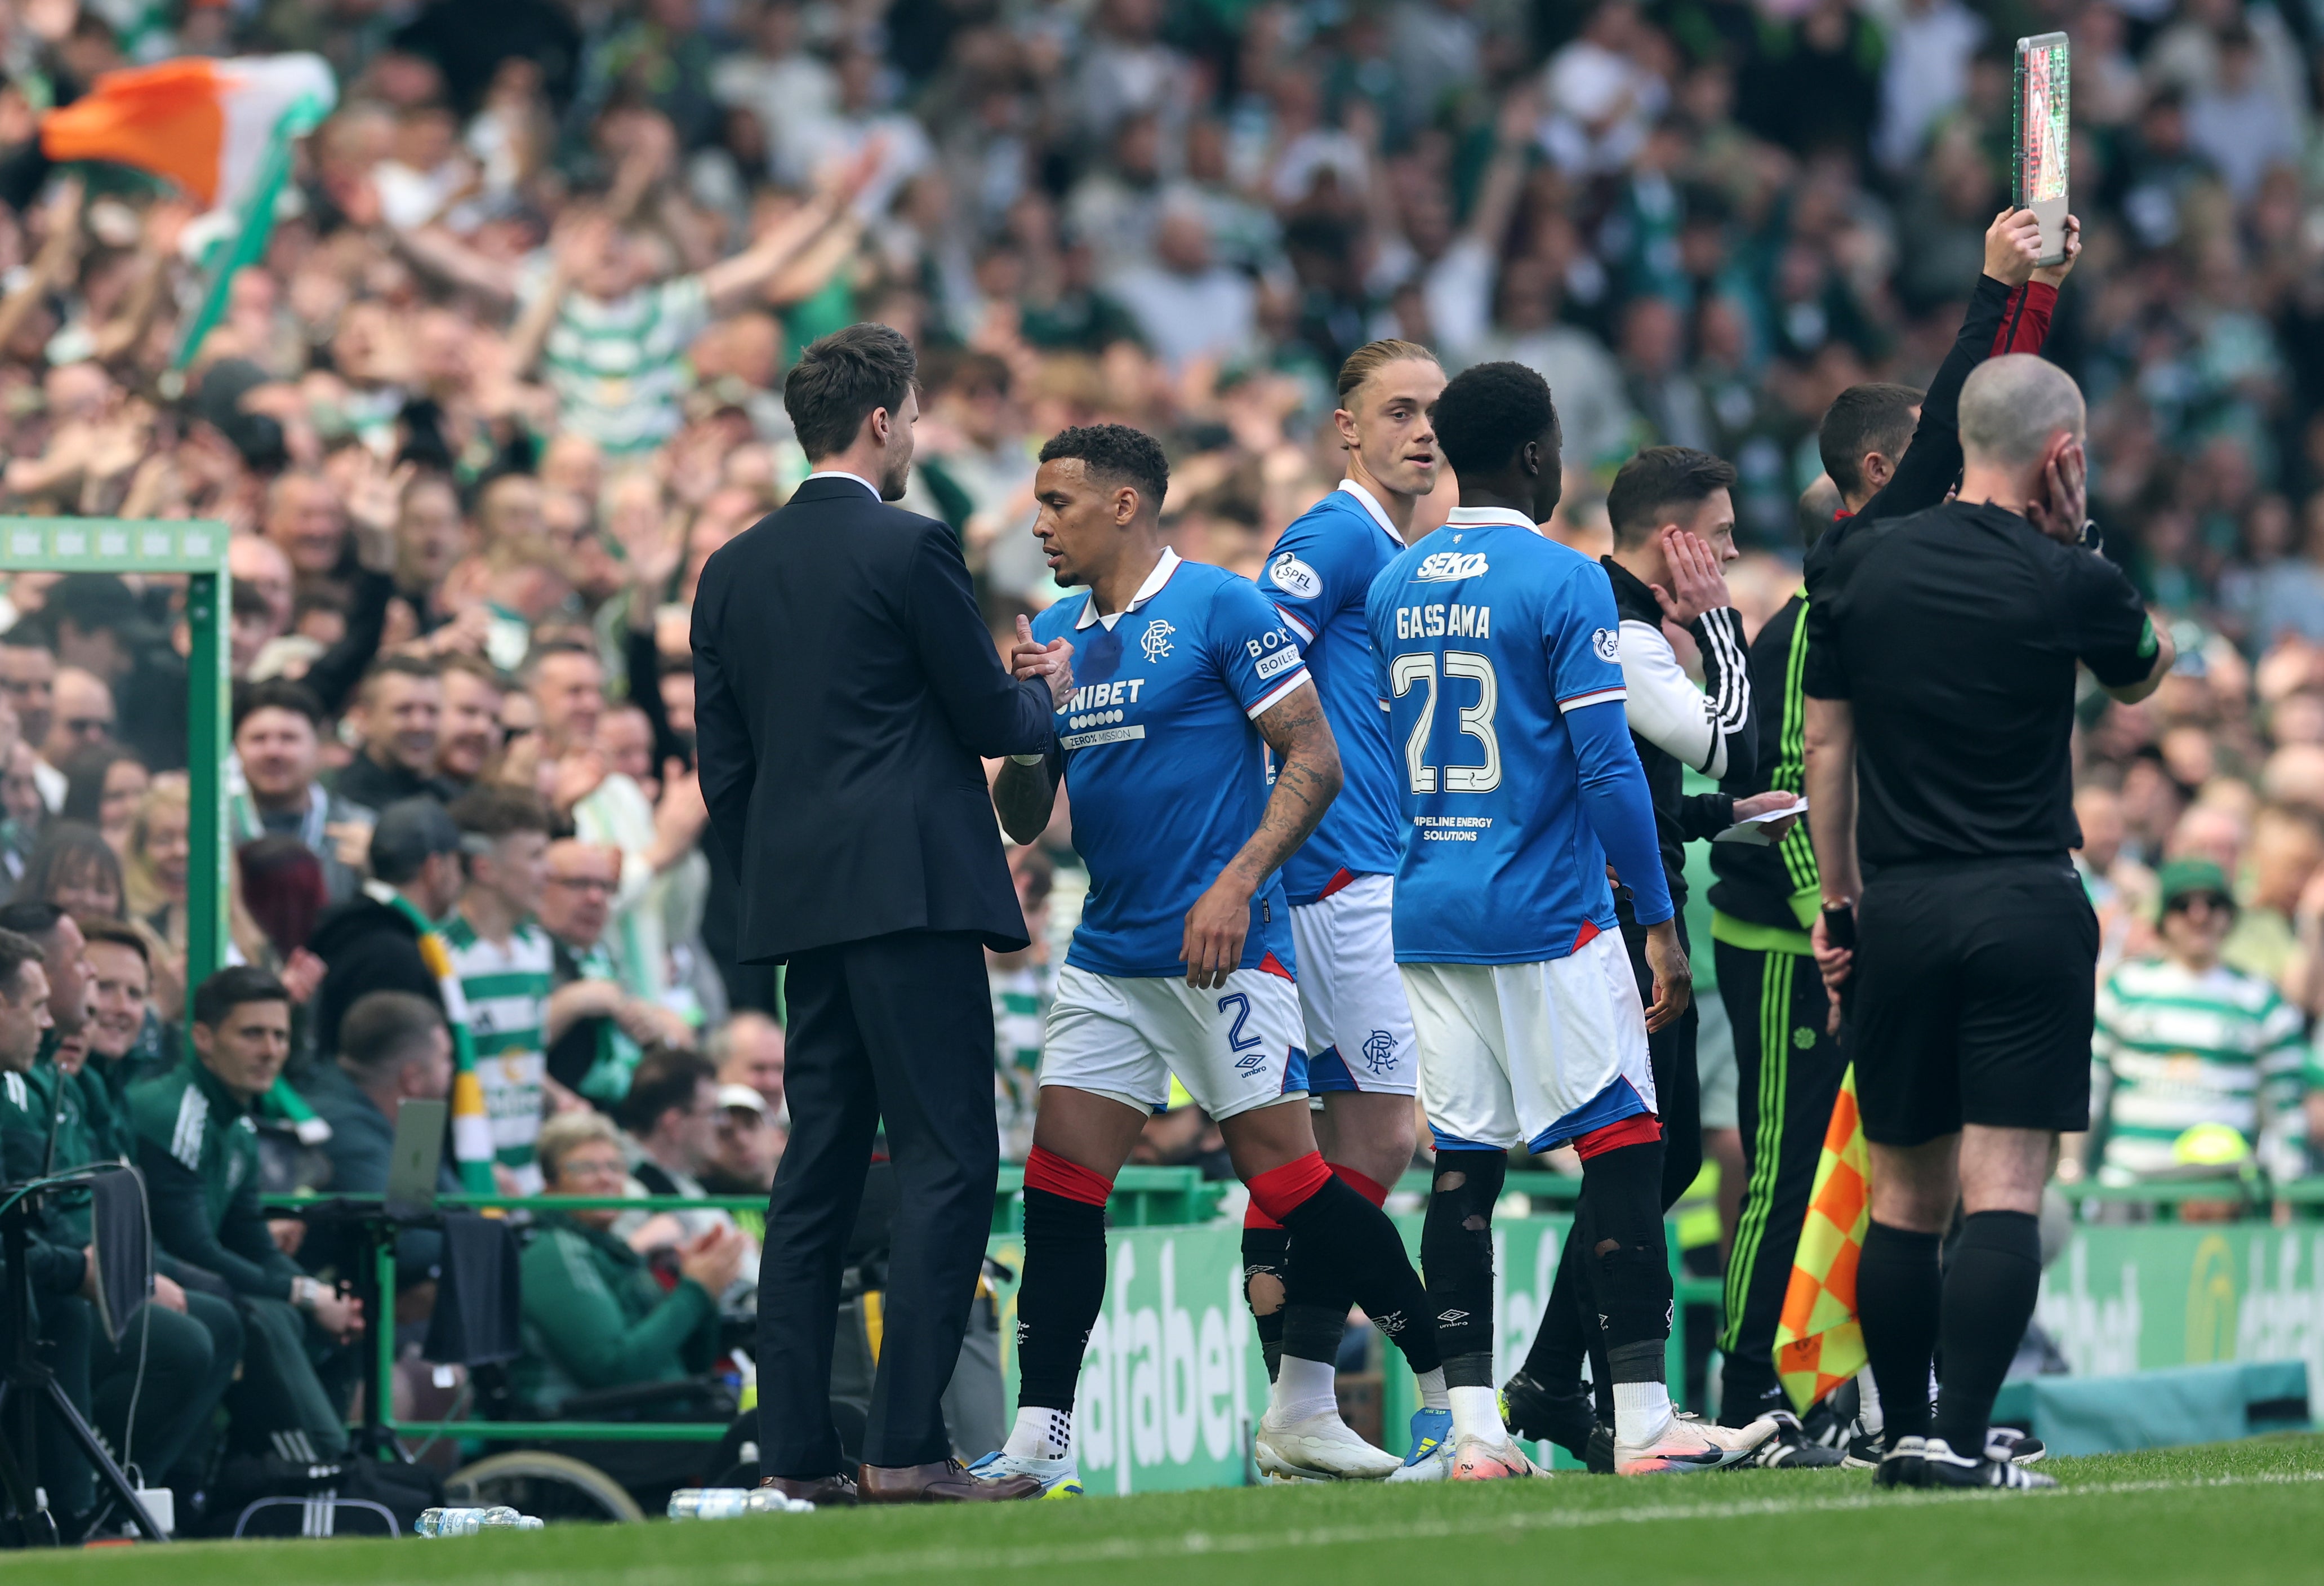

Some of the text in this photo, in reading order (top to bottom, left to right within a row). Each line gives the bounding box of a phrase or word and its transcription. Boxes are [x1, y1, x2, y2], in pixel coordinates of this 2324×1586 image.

[1417, 552, 1489, 577] SEKO
[1283, 567, 1310, 589] SPFL
[1397, 603, 1490, 639] GASSAMA
[1056, 678, 1145, 716] NIBET
[1390, 650, 1502, 795] 23
[1070, 728, 1131, 747] ZERO% MISSION
[1413, 816, 1493, 828] IPELINE ENERGY
[1423, 830, 1477, 842] SOLUTIONS
[1217, 991, 1263, 1054] 2
[1241, 1066, 1267, 1078] umbro
[1068, 1238, 1250, 1497] afabet
